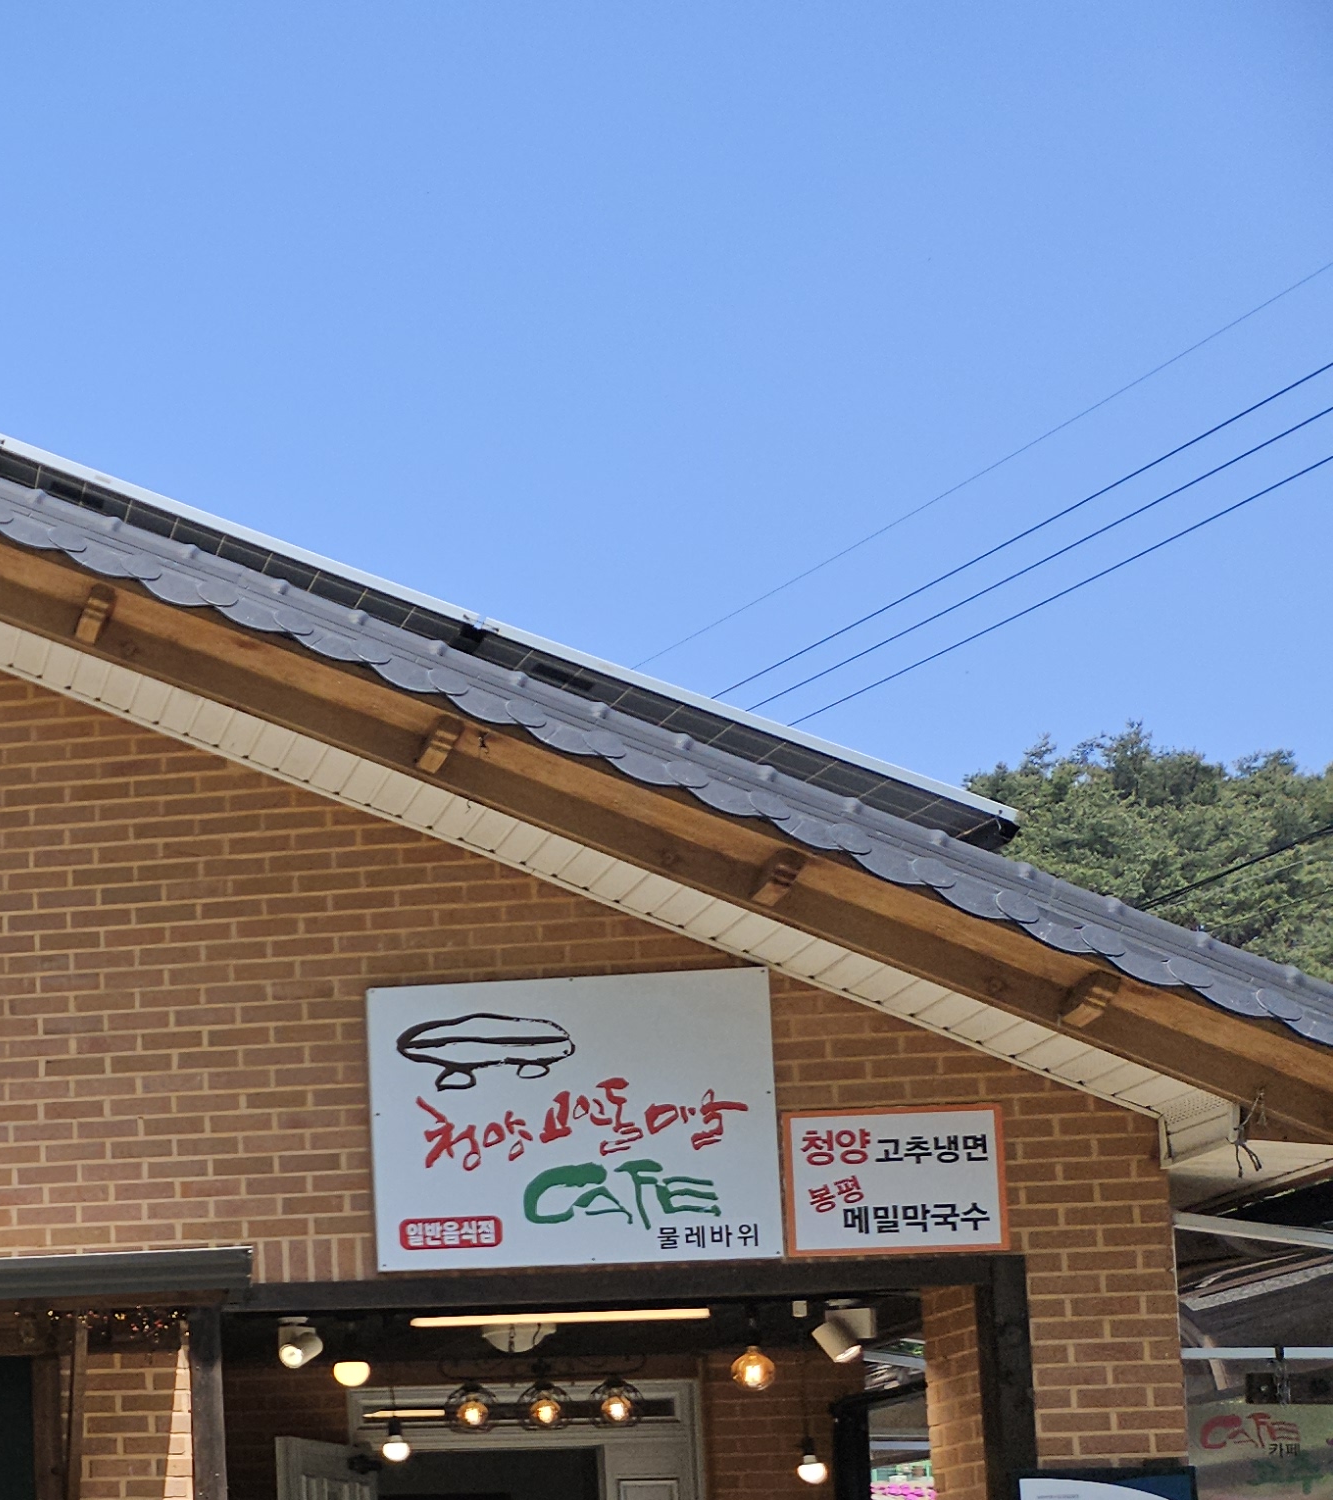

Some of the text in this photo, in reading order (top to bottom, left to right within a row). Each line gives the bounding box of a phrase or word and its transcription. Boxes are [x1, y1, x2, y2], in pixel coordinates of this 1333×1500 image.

[800, 1128, 989, 1166] 청양 고추냉면
[523, 1159, 722, 1230] CAFE
[807, 1175, 865, 1214] 봉평
[405, 1219, 496, 1246] 일반음식점
[656, 1223, 760, 1249] 물레바위
[842, 1202, 991, 1235] 메밀막국수
[1199, 1412, 1301, 1450] CAFE
[1268, 1443, 1301, 1459] 카페
